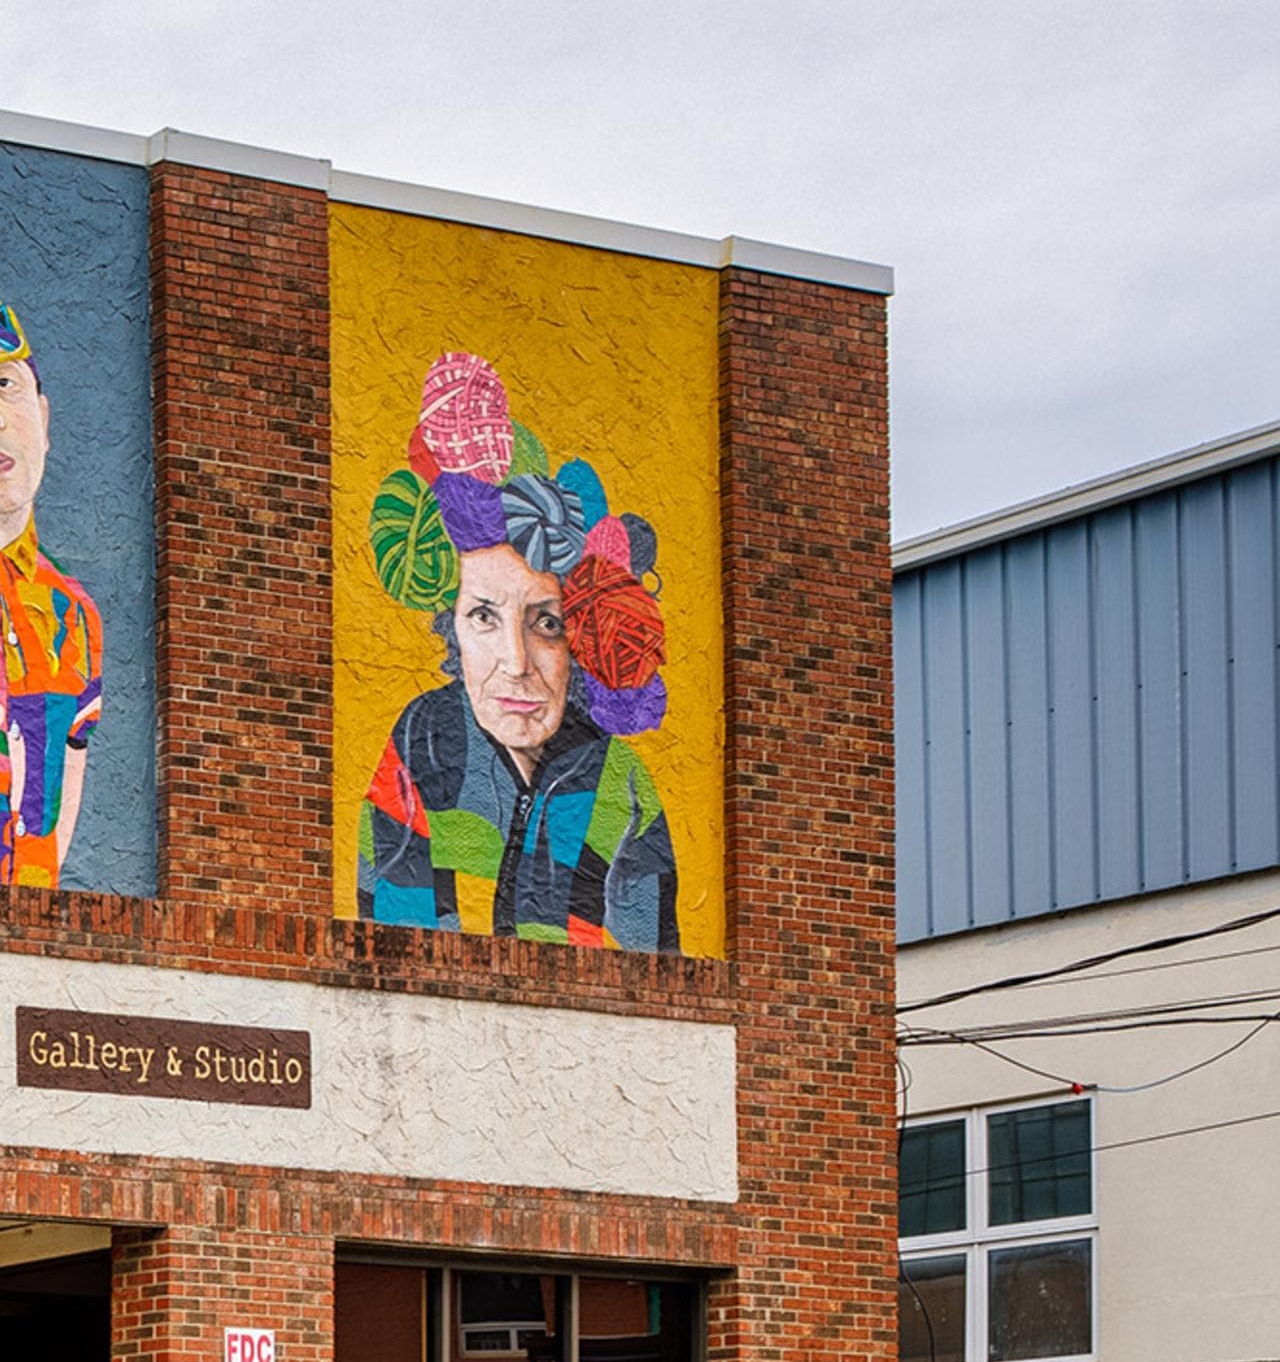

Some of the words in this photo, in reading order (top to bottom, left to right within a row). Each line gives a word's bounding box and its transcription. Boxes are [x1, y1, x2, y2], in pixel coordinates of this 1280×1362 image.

[29, 1030, 156, 1083] Gallery
[166, 1049, 182, 1078] &
[195, 1044, 302, 1085] Studio
